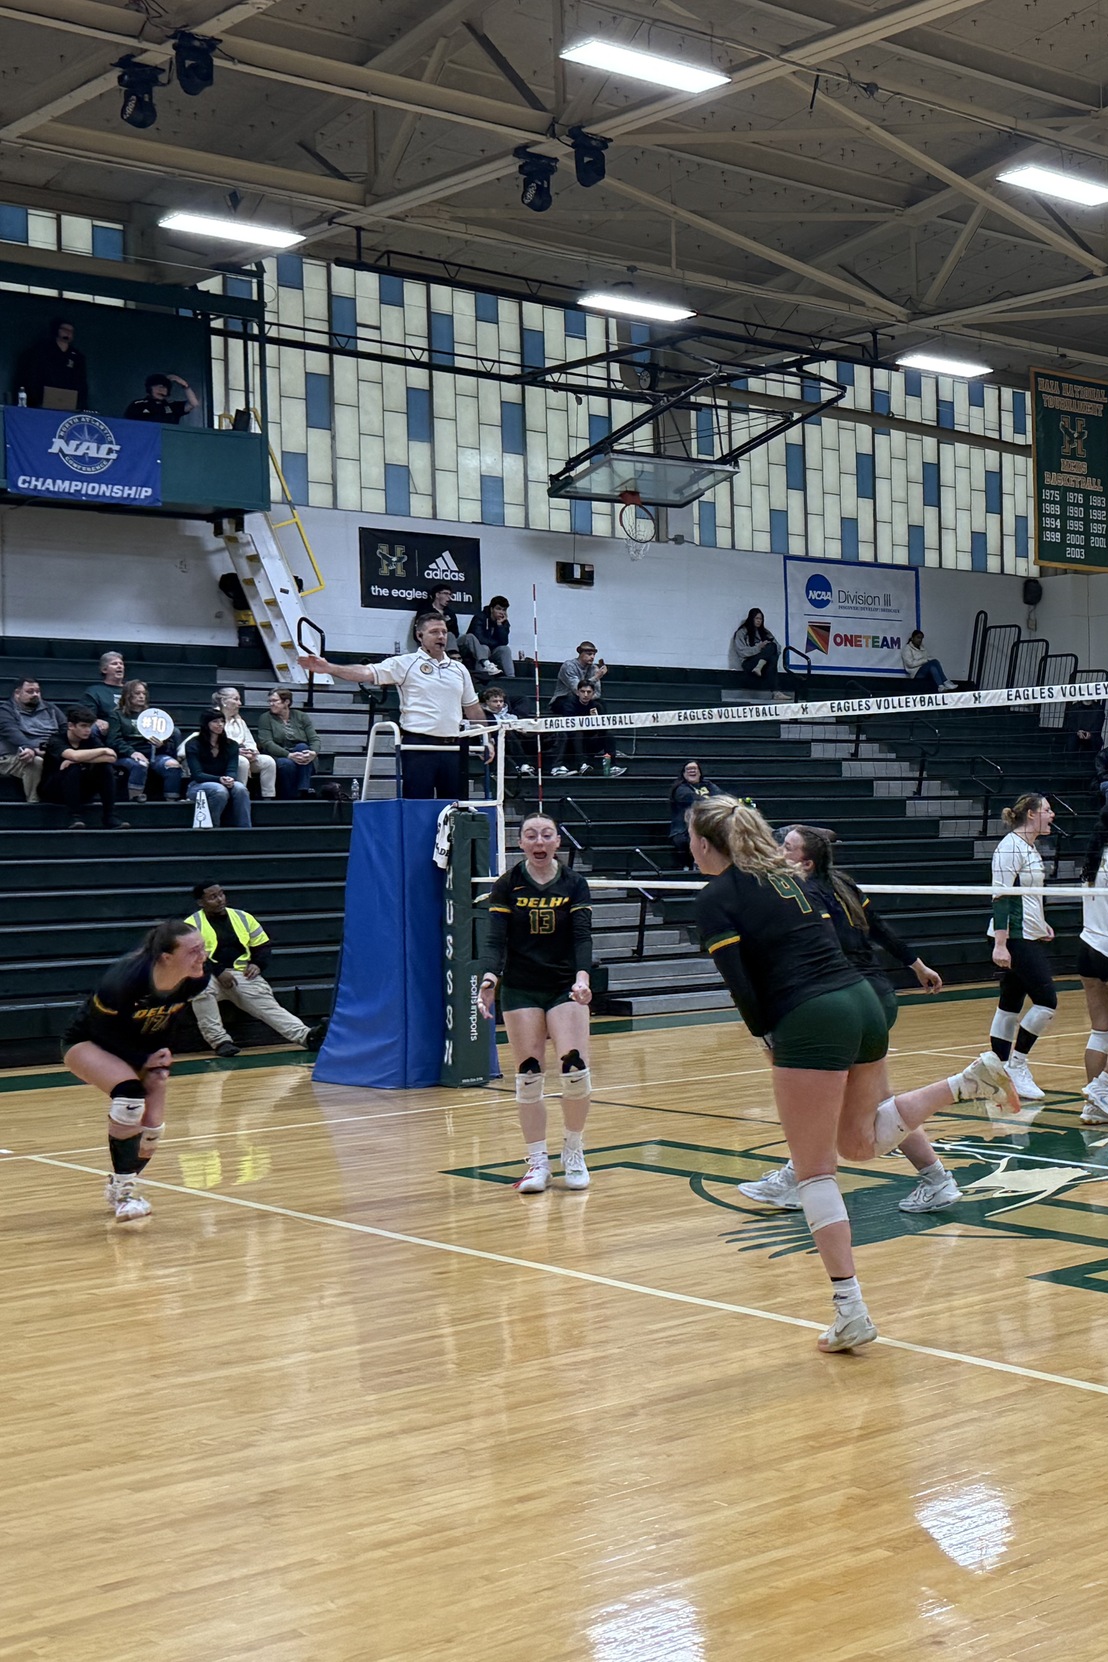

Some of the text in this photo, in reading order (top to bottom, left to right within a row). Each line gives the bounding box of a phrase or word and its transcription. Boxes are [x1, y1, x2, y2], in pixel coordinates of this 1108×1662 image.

[48, 438, 121, 460] NAC
[17, 475, 153, 499] CHAMPIONSHIP
[1044, 471, 1104, 492] BASKETBALL
[1042, 489, 1106, 507] 1975 1976 1983
[1042, 503, 1106, 521] 1989 1990 1992
[1042, 517, 1107, 534] 1994 1995 1997
[1043, 531, 1107, 548] 1999 2000 2001
[1066, 547, 1085, 559] 2003
[424, 568, 466, 582] adidas
[371, 585, 429, 601] the eagles
[463, 592, 473, 603] in
[808, 589, 833, 601] NCAA
[838, 590, 892, 607] Division III
[1006, 685, 1055, 701] EAGLES
[829, 694, 949, 713] EAGLES VOLLEYBALL
[544, 713, 635, 730] EAGLES VOLLEYBALL
[676, 705, 780, 722] EAGLES VOLLEYBALL
[141, 716, 167, 733] #10
[529, 909, 556, 934] 13
[469, 974, 479, 1042] sports imports
